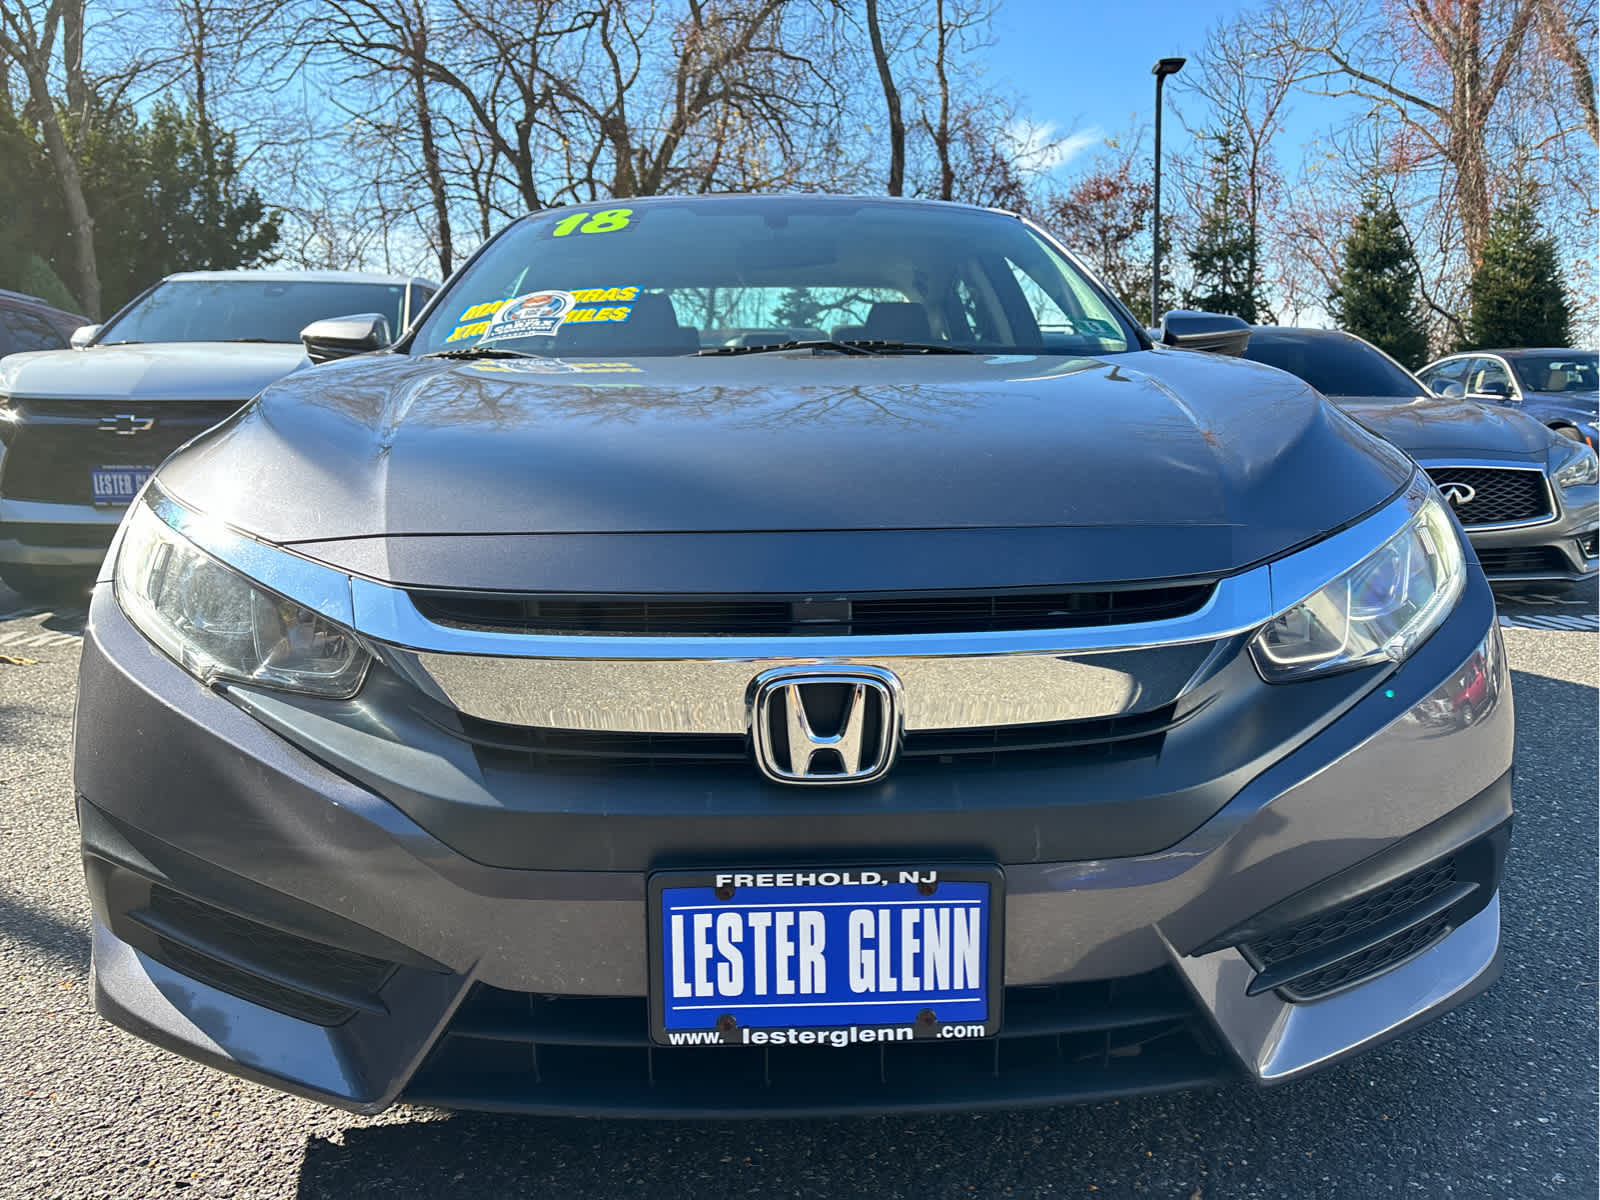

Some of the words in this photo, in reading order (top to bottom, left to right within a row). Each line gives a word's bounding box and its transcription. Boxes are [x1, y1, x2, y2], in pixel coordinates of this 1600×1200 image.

[553, 208, 633, 237] 18
[569, 287, 639, 303] TRAS
[446, 320, 492, 342] XTR
[93, 474, 133, 495] LESTER
[716, 872, 888, 888] FREEHOLD,
[899, 871, 937, 884] NJ
[671, 910, 827, 998] LESTER
[848, 907, 981, 994] GLENN
[669, 1031, 725, 1045] www.
[742, 1025, 913, 1047] lesterglenn
[937, 1023, 985, 1039] .com
